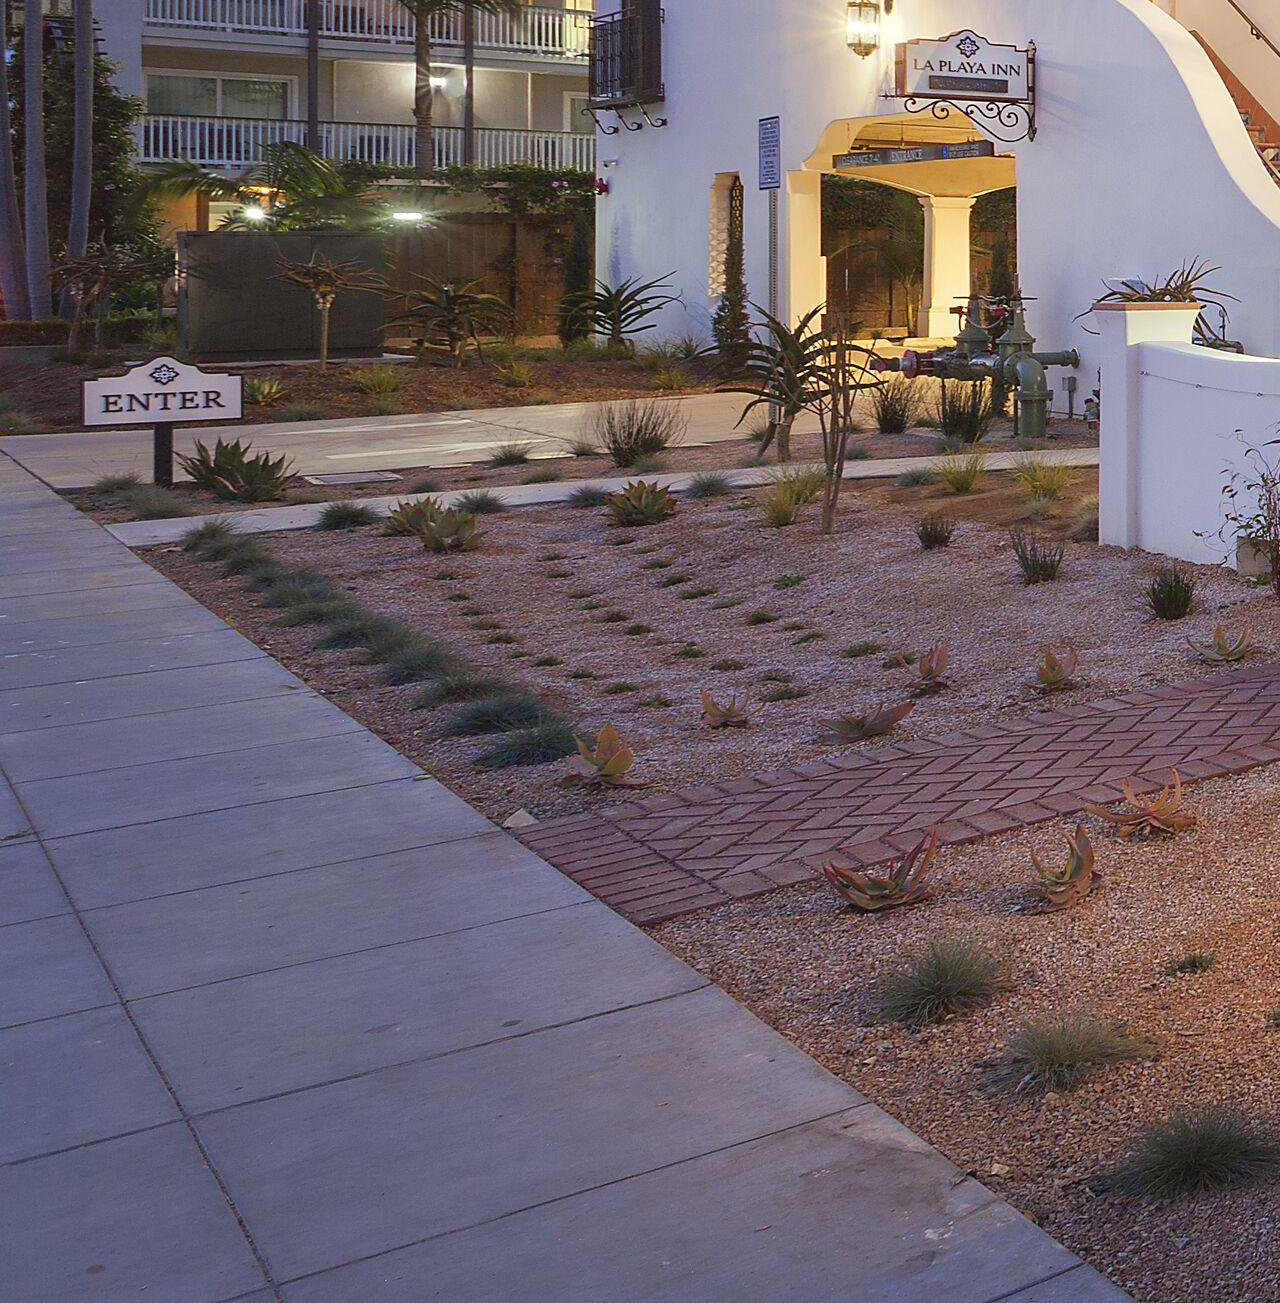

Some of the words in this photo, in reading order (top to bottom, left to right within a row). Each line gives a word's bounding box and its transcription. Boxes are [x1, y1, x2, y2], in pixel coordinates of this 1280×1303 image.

[914, 59, 934, 71] LA
[939, 60, 986, 74] PLAYA
[992, 64, 1020, 76] INN
[891, 149, 923, 162] ENTRANCE
[101, 390, 226, 413] ENTER
